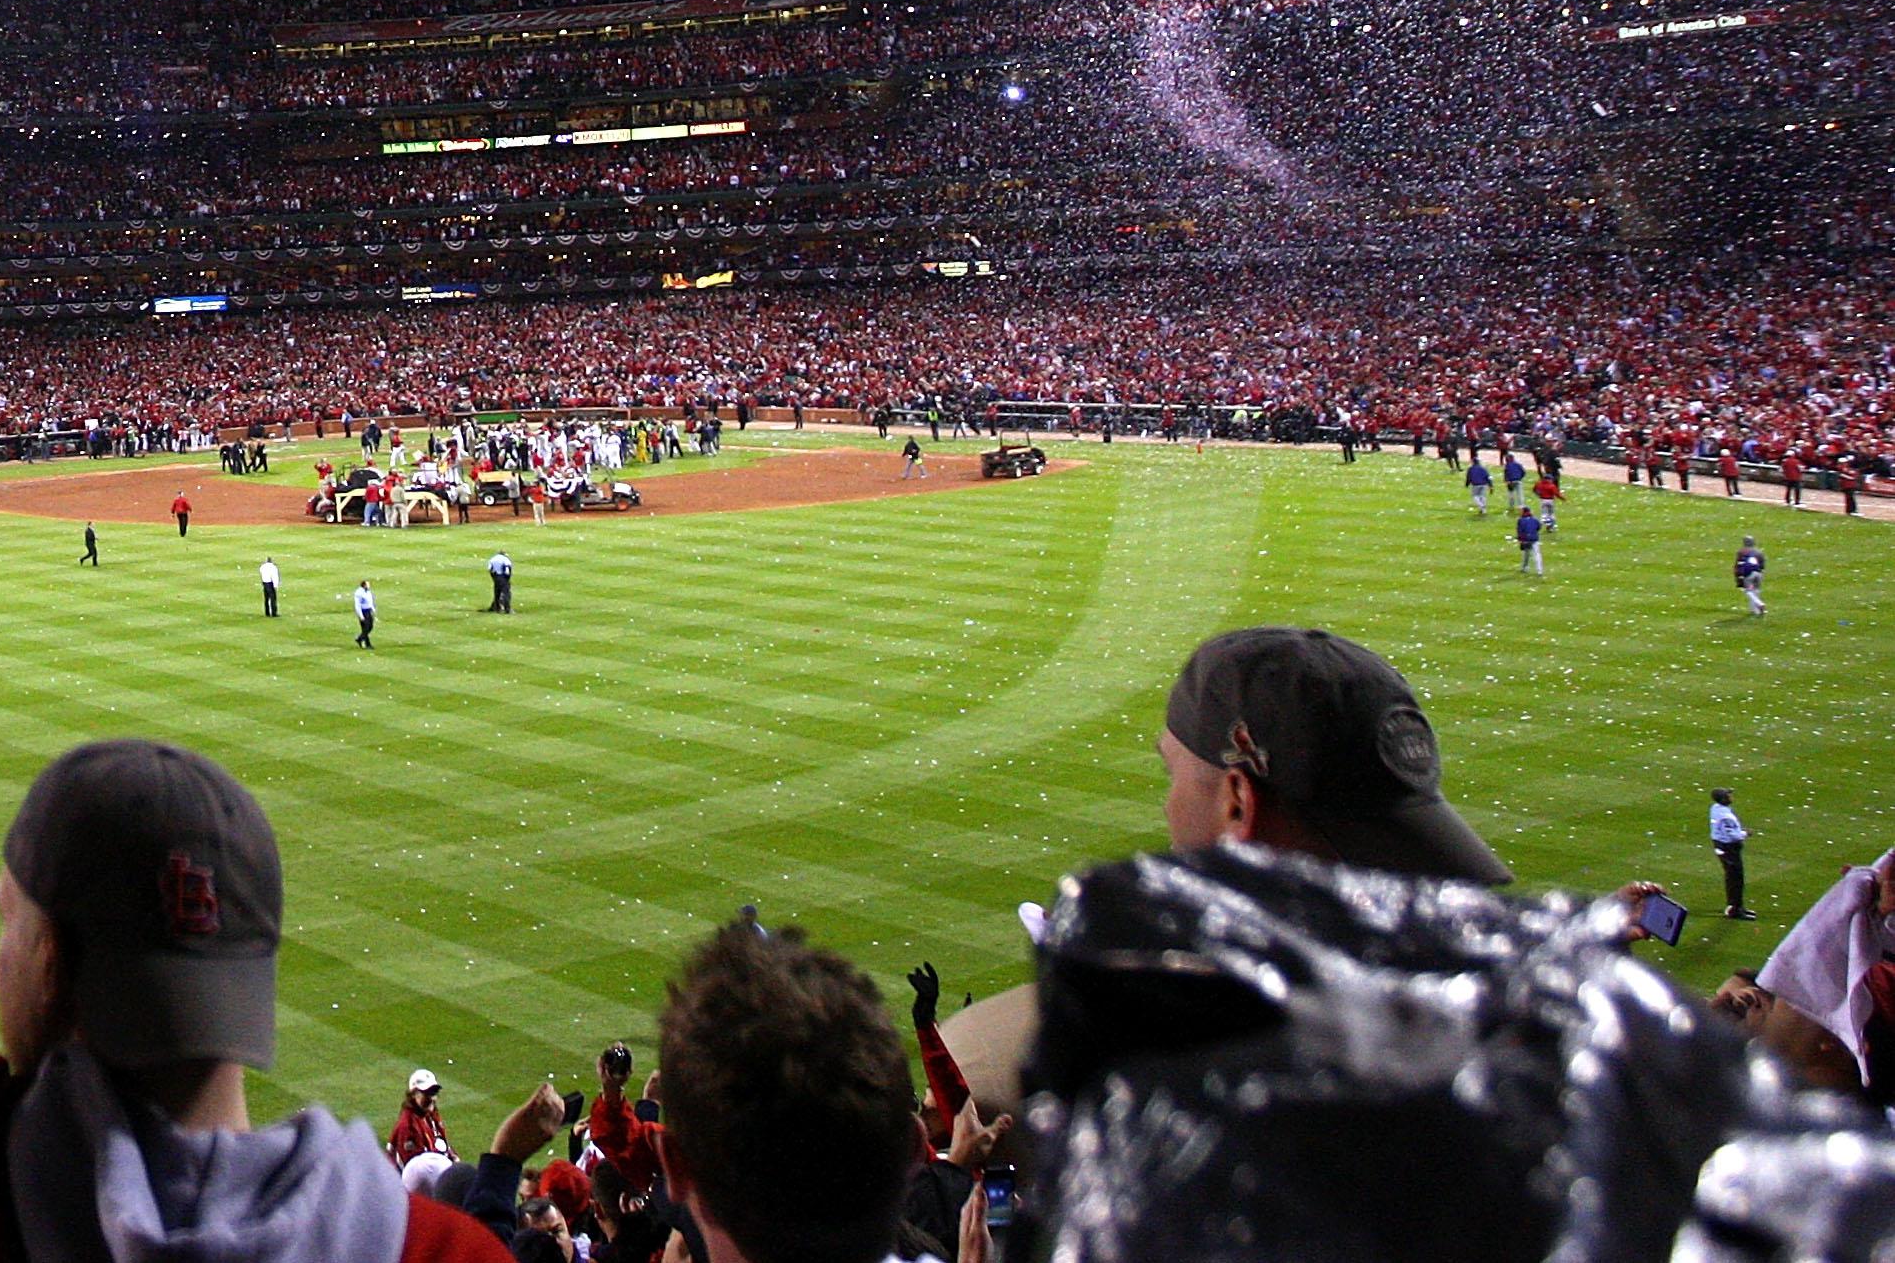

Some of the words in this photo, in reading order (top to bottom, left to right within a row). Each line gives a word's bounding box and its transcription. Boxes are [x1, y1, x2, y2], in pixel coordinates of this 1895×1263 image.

[442, 0, 686, 31] Budweiser
[1619, 26, 1649, 38] Bank
[1651, 23, 1664, 34] of
[1667, 19, 1716, 32] America
[1718, 16, 1746, 27] Club
